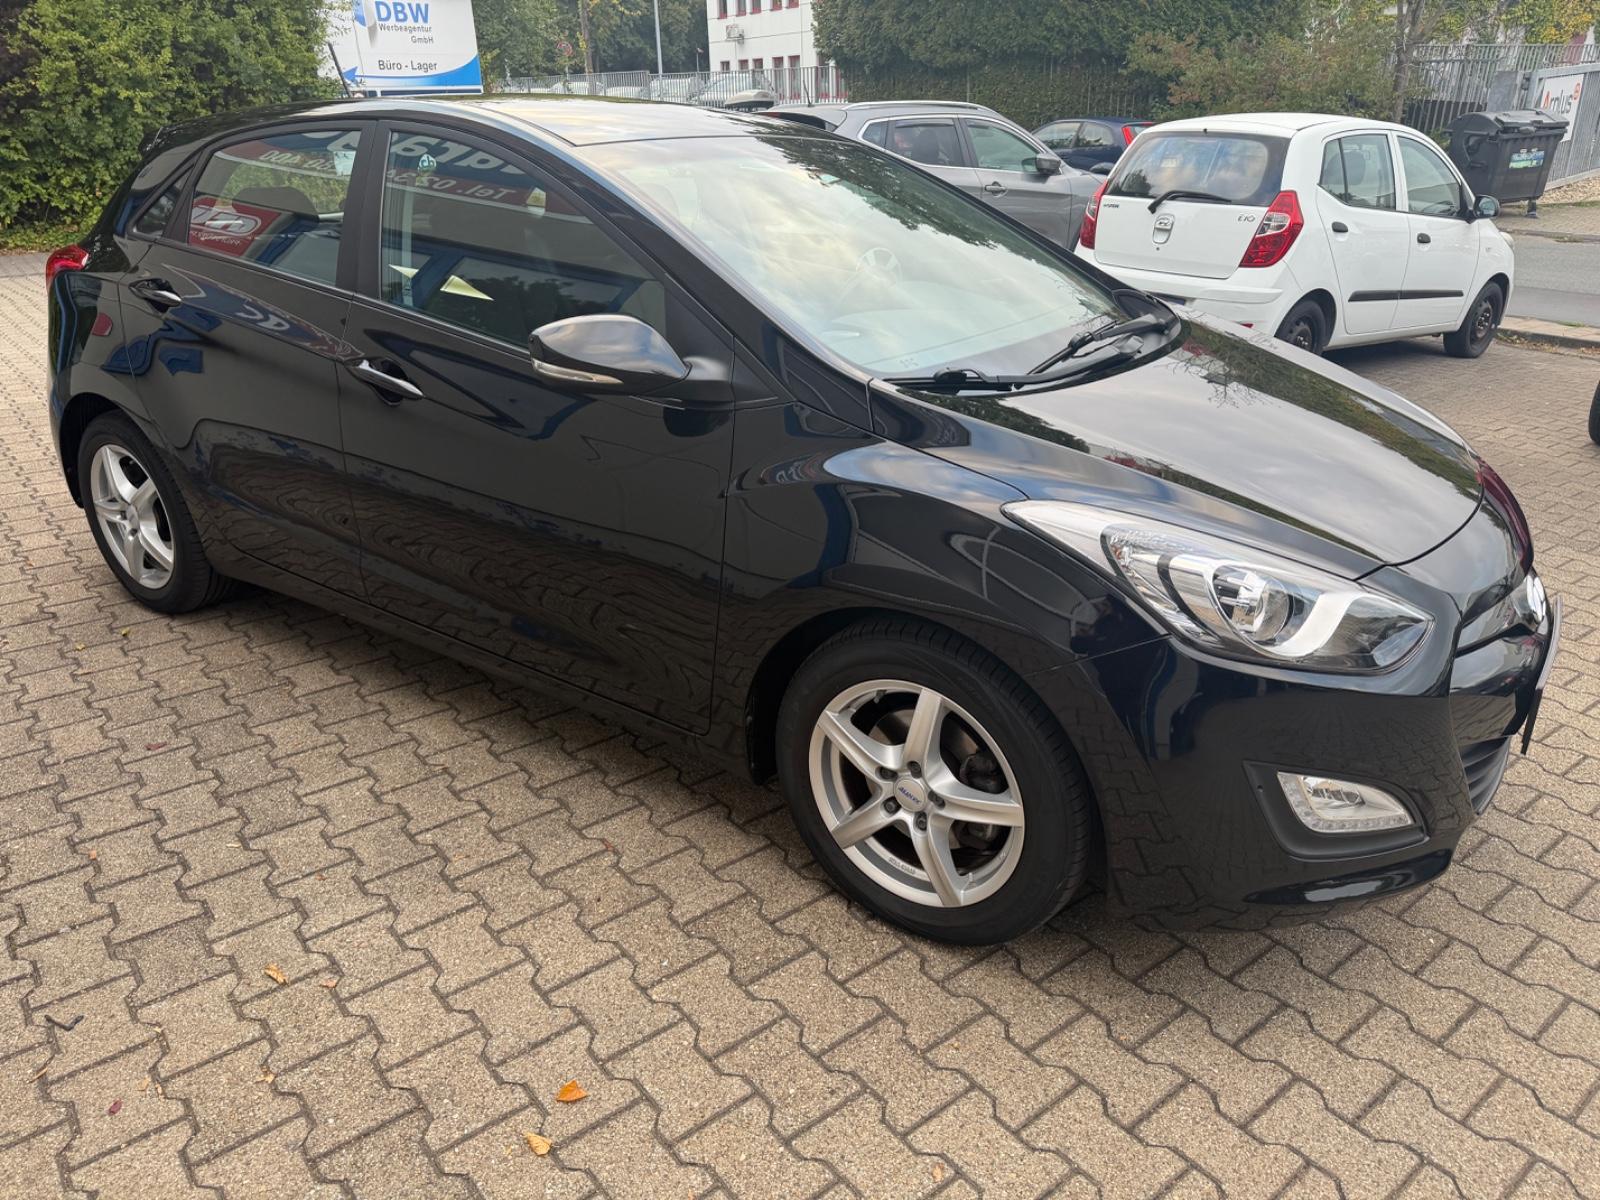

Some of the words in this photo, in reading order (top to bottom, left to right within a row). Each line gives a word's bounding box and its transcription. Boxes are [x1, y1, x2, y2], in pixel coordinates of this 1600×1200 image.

[375, 1, 429, 24] DBW
[378, 24, 432, 33] Werbeagentur
[411, 35, 434, 44] GmbH
[378, 60, 402, 71] Büro
[411, 60, 438, 71] Lager
